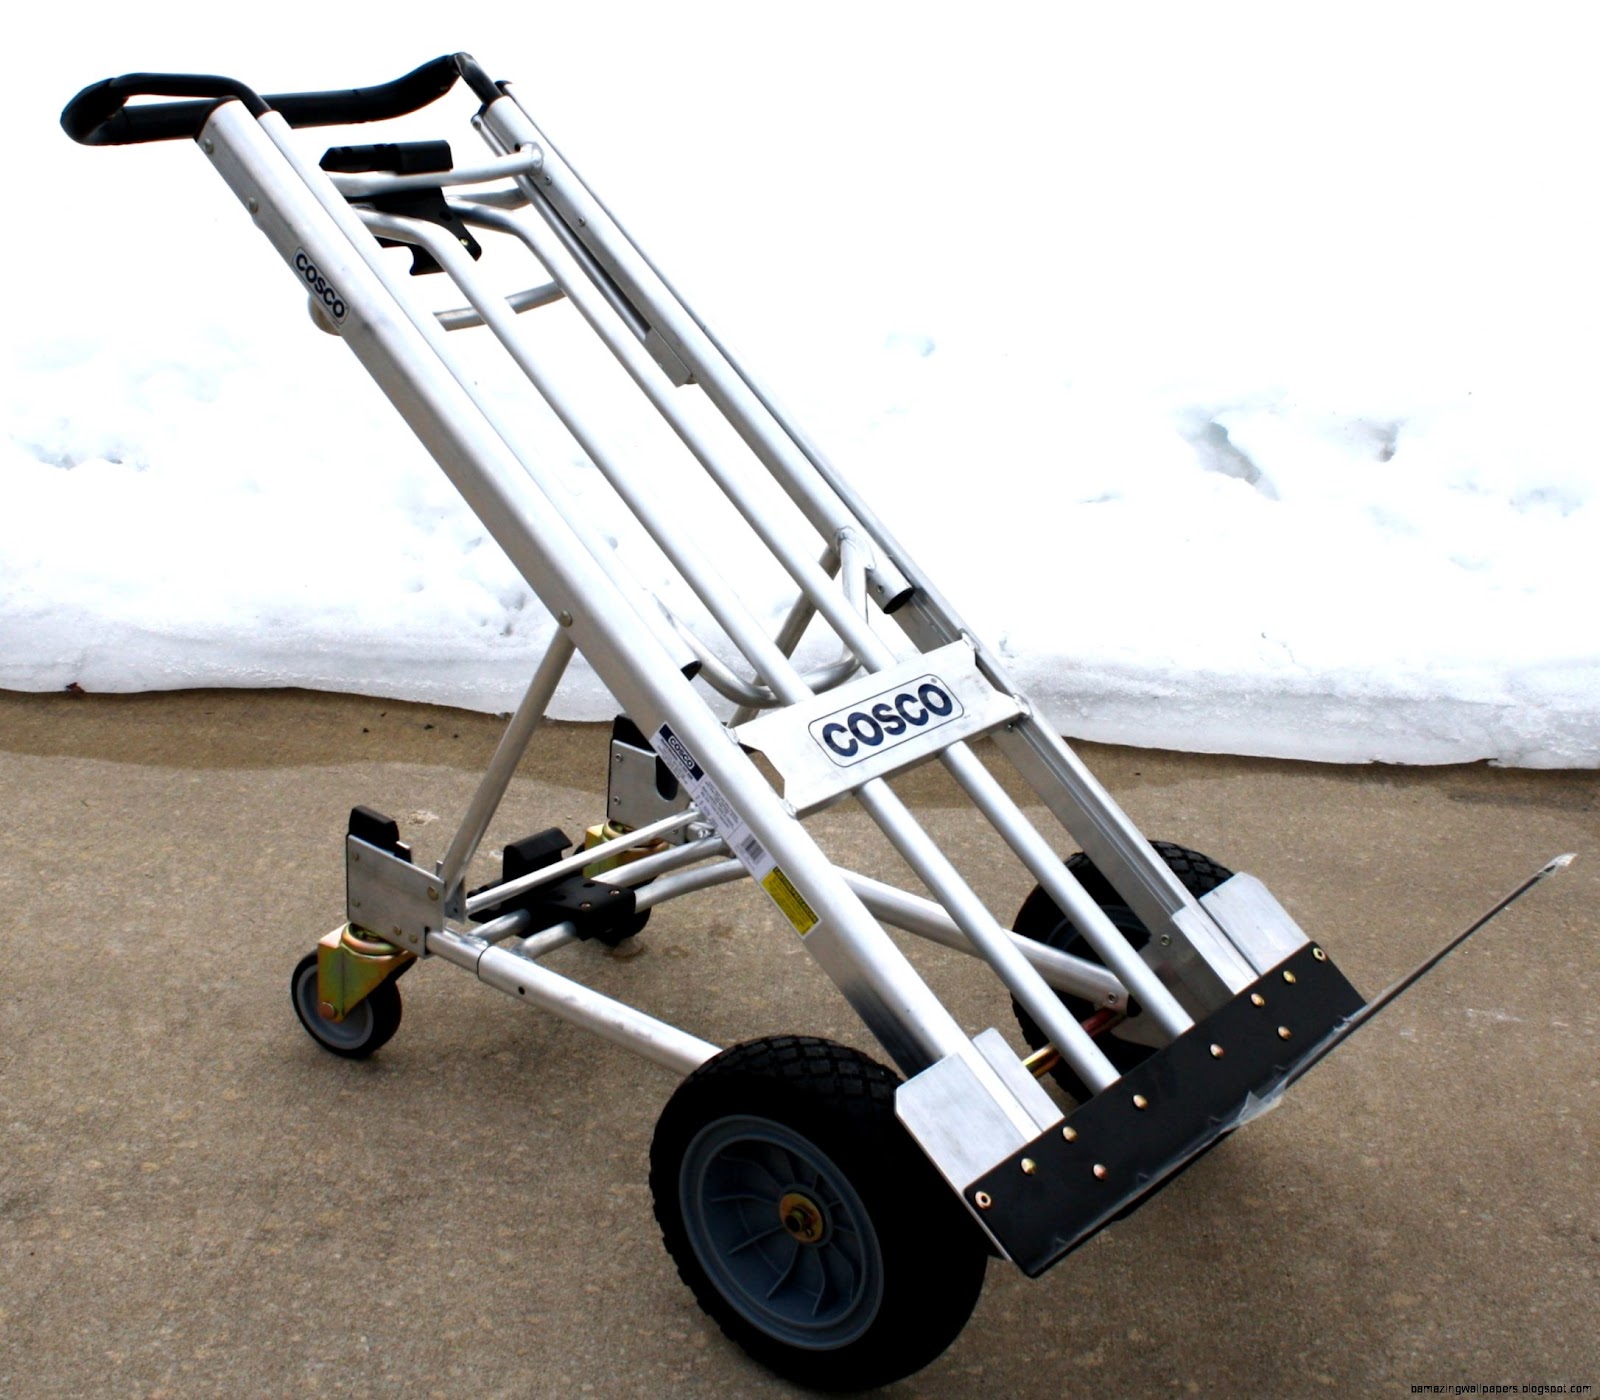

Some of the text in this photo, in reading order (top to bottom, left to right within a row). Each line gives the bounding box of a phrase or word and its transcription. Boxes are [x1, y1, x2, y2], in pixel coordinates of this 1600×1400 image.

[296, 253, 345, 318] COSCO
[822, 683, 953, 757] COSCO
[670, 738, 693, 768] COSCO
